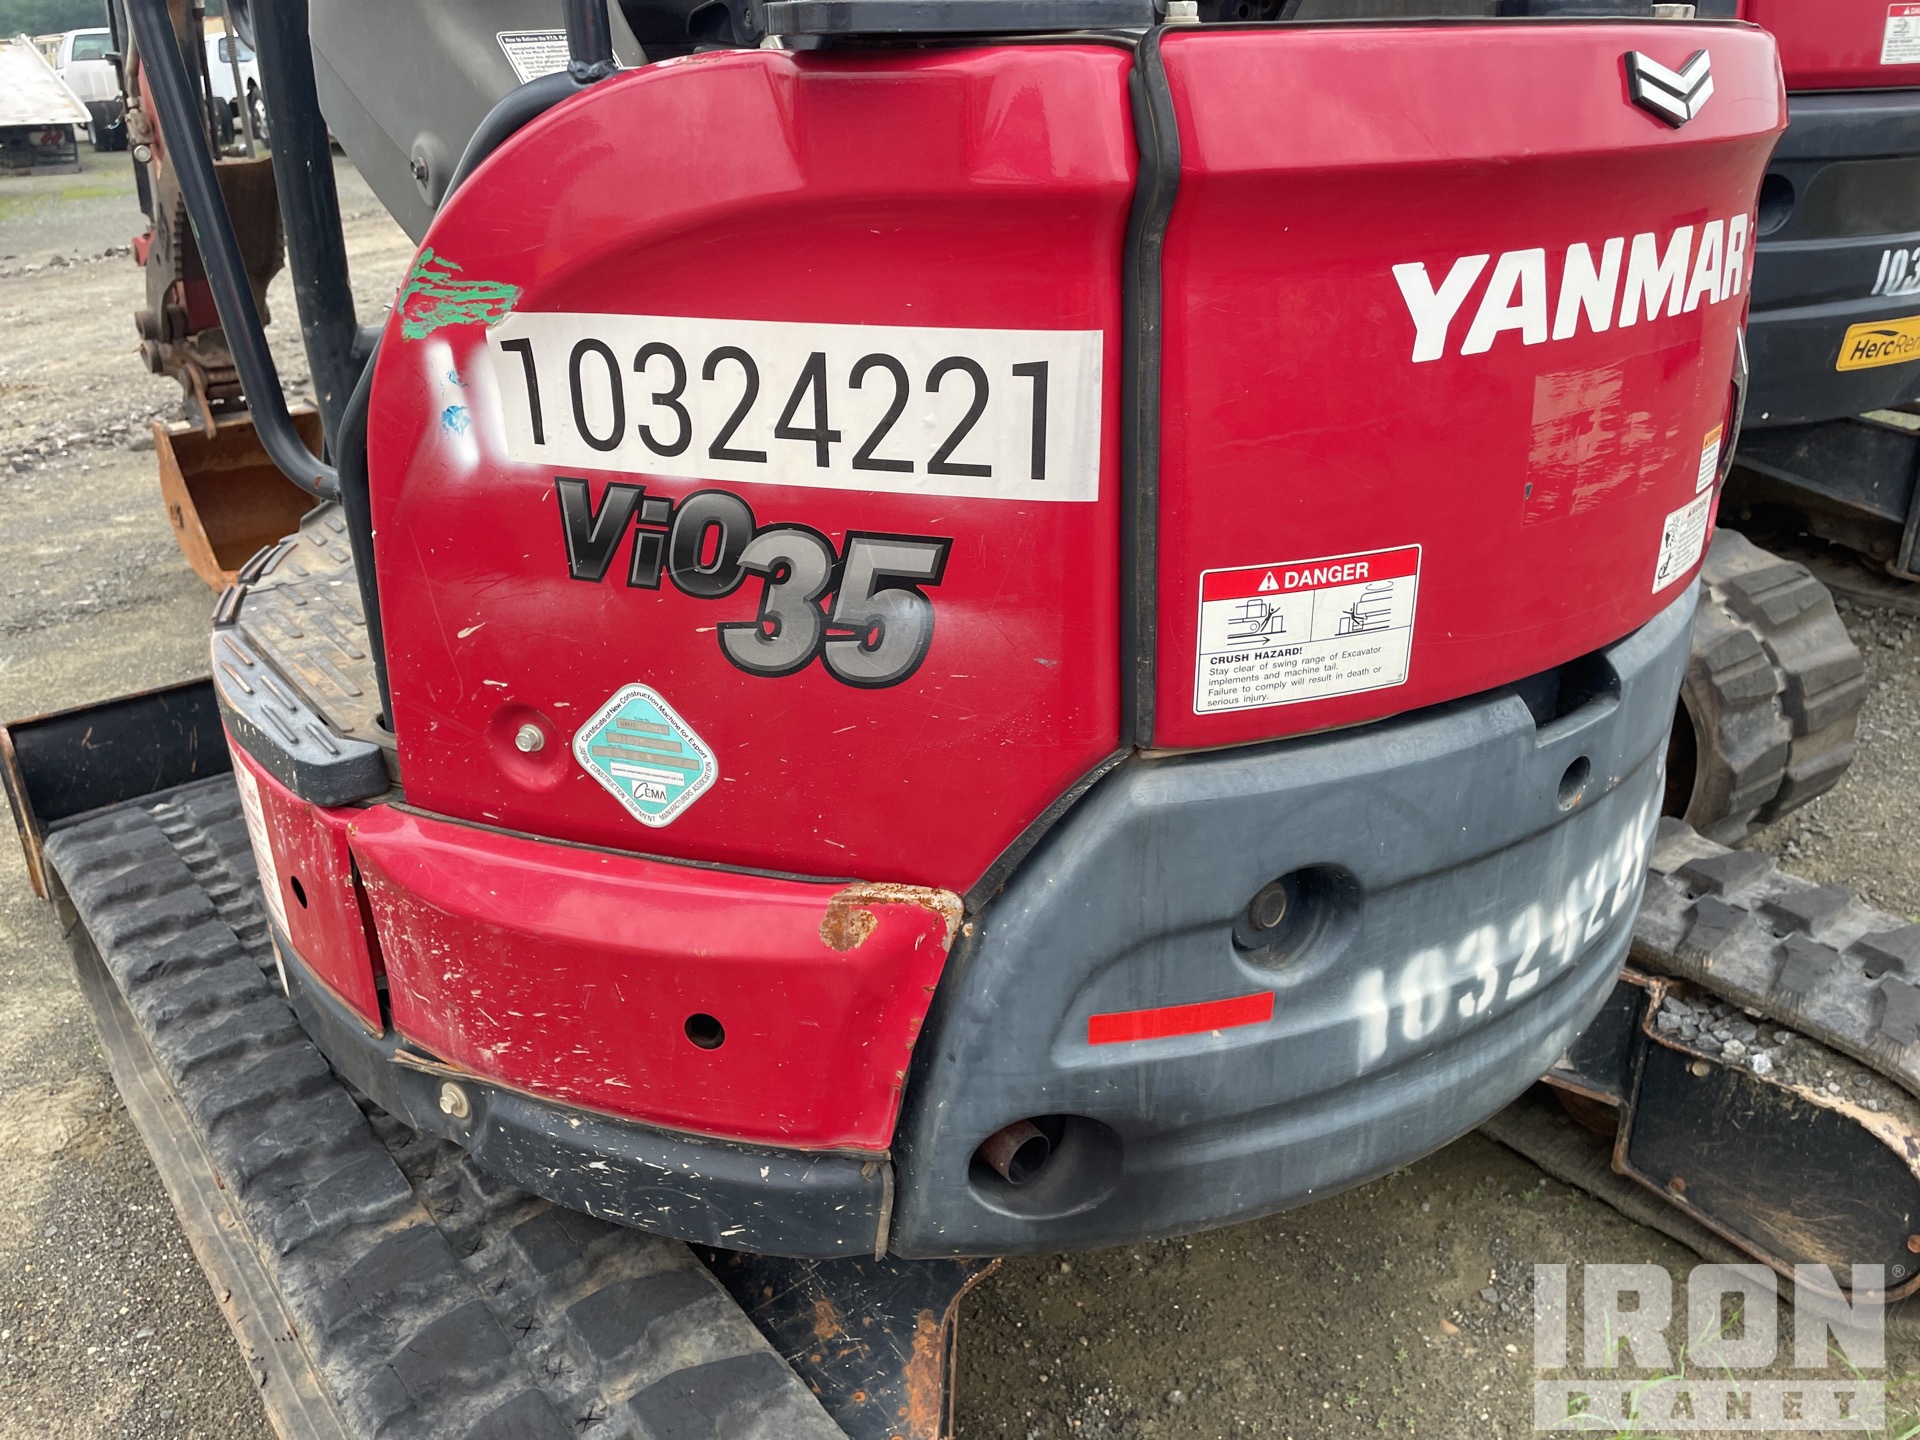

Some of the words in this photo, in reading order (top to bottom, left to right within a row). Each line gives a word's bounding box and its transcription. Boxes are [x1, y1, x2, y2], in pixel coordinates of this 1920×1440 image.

[1392, 212, 1748, 363] YANMAR
[500, 338, 1049, 480] 10324221
[1284, 562, 1369, 589] DANGER
[1209, 667, 1229, 676] Stay
[1233, 665, 1255, 673] clear
[1260, 662, 1269, 670] of
[1272, 659, 1297, 668] swing
[1301, 655, 1325, 664] range
[1329, 652, 1338, 660] of
[1342, 647, 1382, 659] Excavator
[1210, 654, 1249, 665] CRUSH
[1254, 647, 1303, 660] HAZARD!
[1208, 674, 1259, 686] implements
[1263, 671, 1280, 680] and
[1284, 667, 1320, 677] machine
[1324, 663, 1338, 671] tail.
[1208, 687, 1237, 696] Failure
[1255, 681, 1287, 690] comply
[1291, 678, 1305, 686] will
[1309, 674, 1331, 684] result
[1335, 672, 1343, 680] in
[1347, 667, 1369, 678] death
[1207, 697, 1239, 707] serious
[1243, 694, 1269, 703] injury.
[581, 717, 607, 742] Certificate
[605, 710, 612, 720] of
[610, 703, 622, 715] New
[620, 690, 660, 708] Construction
[658, 705, 681, 731] Machine
[680, 729, 689, 738] for
[688, 737, 708, 759] Export
[590, 763, 627, 799] CONSTRUCTION
[625, 798, 656, 822] EQUIPMENT
[634, 782, 667, 800] CEMA
